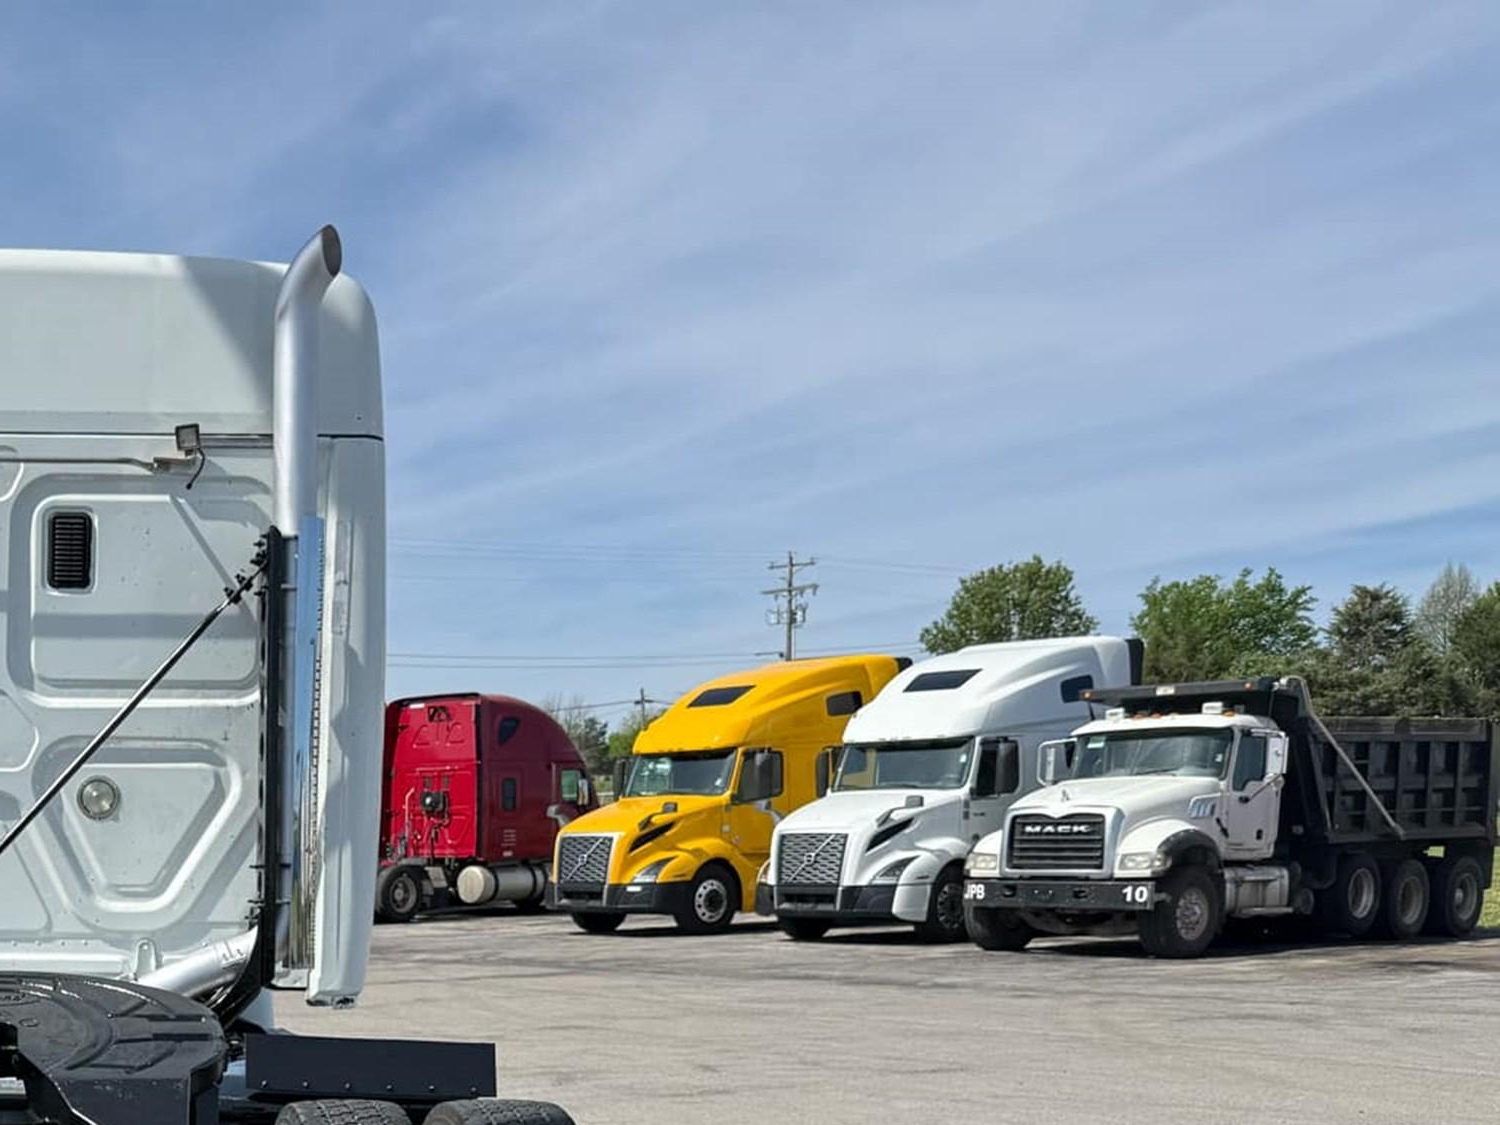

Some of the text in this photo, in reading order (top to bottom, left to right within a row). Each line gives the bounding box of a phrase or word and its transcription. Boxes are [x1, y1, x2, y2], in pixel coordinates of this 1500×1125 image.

[1024, 825, 1092, 834] MACK
[963, 884, 985, 900] JPB
[1122, 885, 1148, 902] 10
